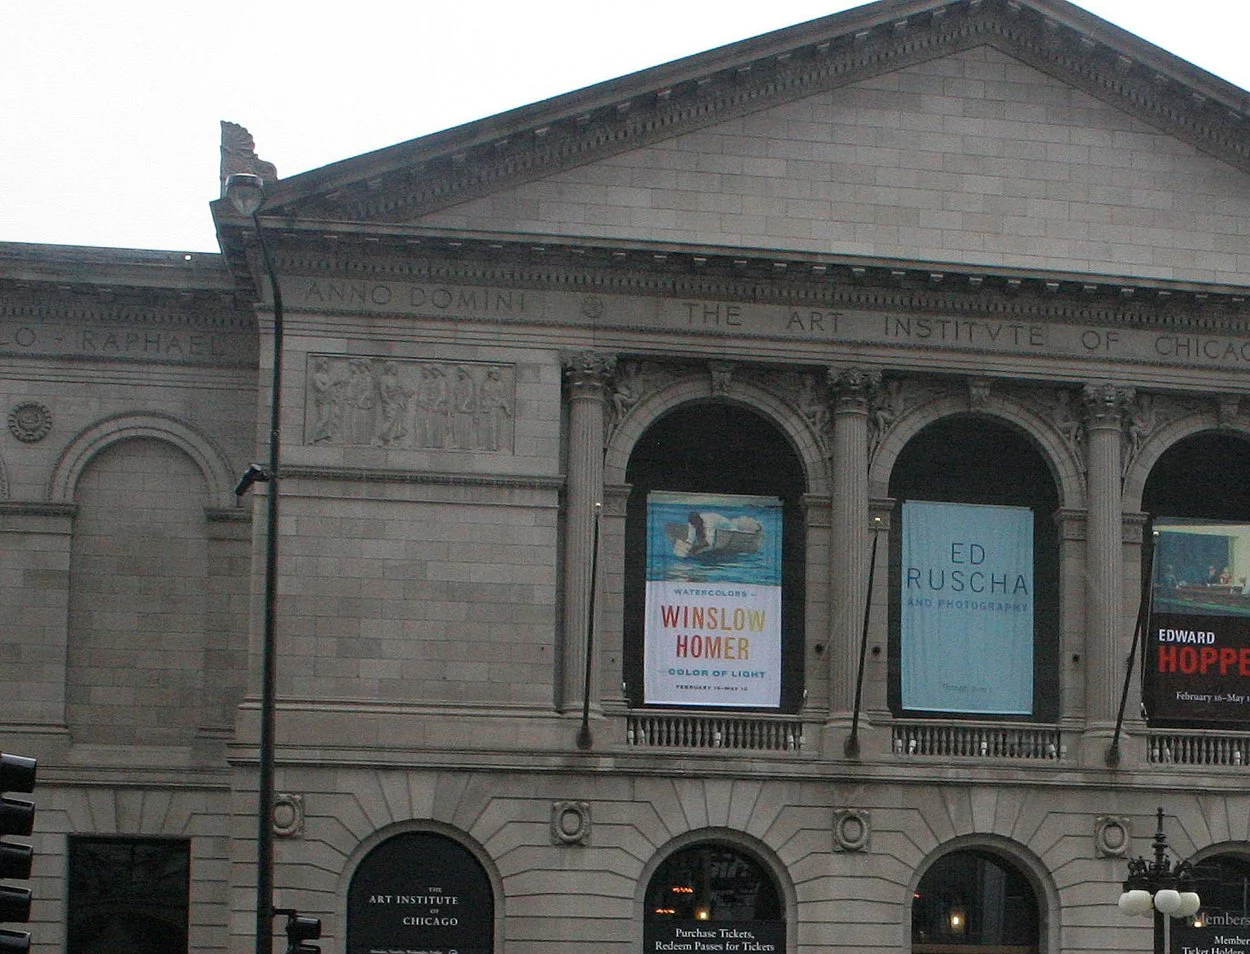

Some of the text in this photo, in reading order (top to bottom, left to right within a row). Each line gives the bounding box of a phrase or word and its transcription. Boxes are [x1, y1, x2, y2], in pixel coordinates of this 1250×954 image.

[305, 282, 526, 312] ANNO DOMINI
[683, 303, 743, 326] THE
[787, 311, 844, 334] ART
[1081, 330, 1120, 351] OF
[81, 330, 227, 356] RAPHAEL
[951, 542, 986, 565] ED
[906, 567, 1029, 595] RUSCHA
[674, 588, 748, 597] WATERCOLORS
[907, 598, 1028, 613] AND PHOTOGRAPHY
[661, 605, 766, 632] WINSLOW
[1158, 629, 1216, 645] EDWARD
[676, 635, 749, 660] HOMER
[668, 668, 709, 677] COLOR
[731, 670, 766, 678] LIGHT
[1176, 691, 1212, 703] February
[369, 895, 459, 905] ART INSTITUTE
[403, 916, 459, 926] CHICAGO
[675, 928, 755, 939] Purchase Tickets,
[655, 940, 775, 952] Redeem Passes for Tickets
